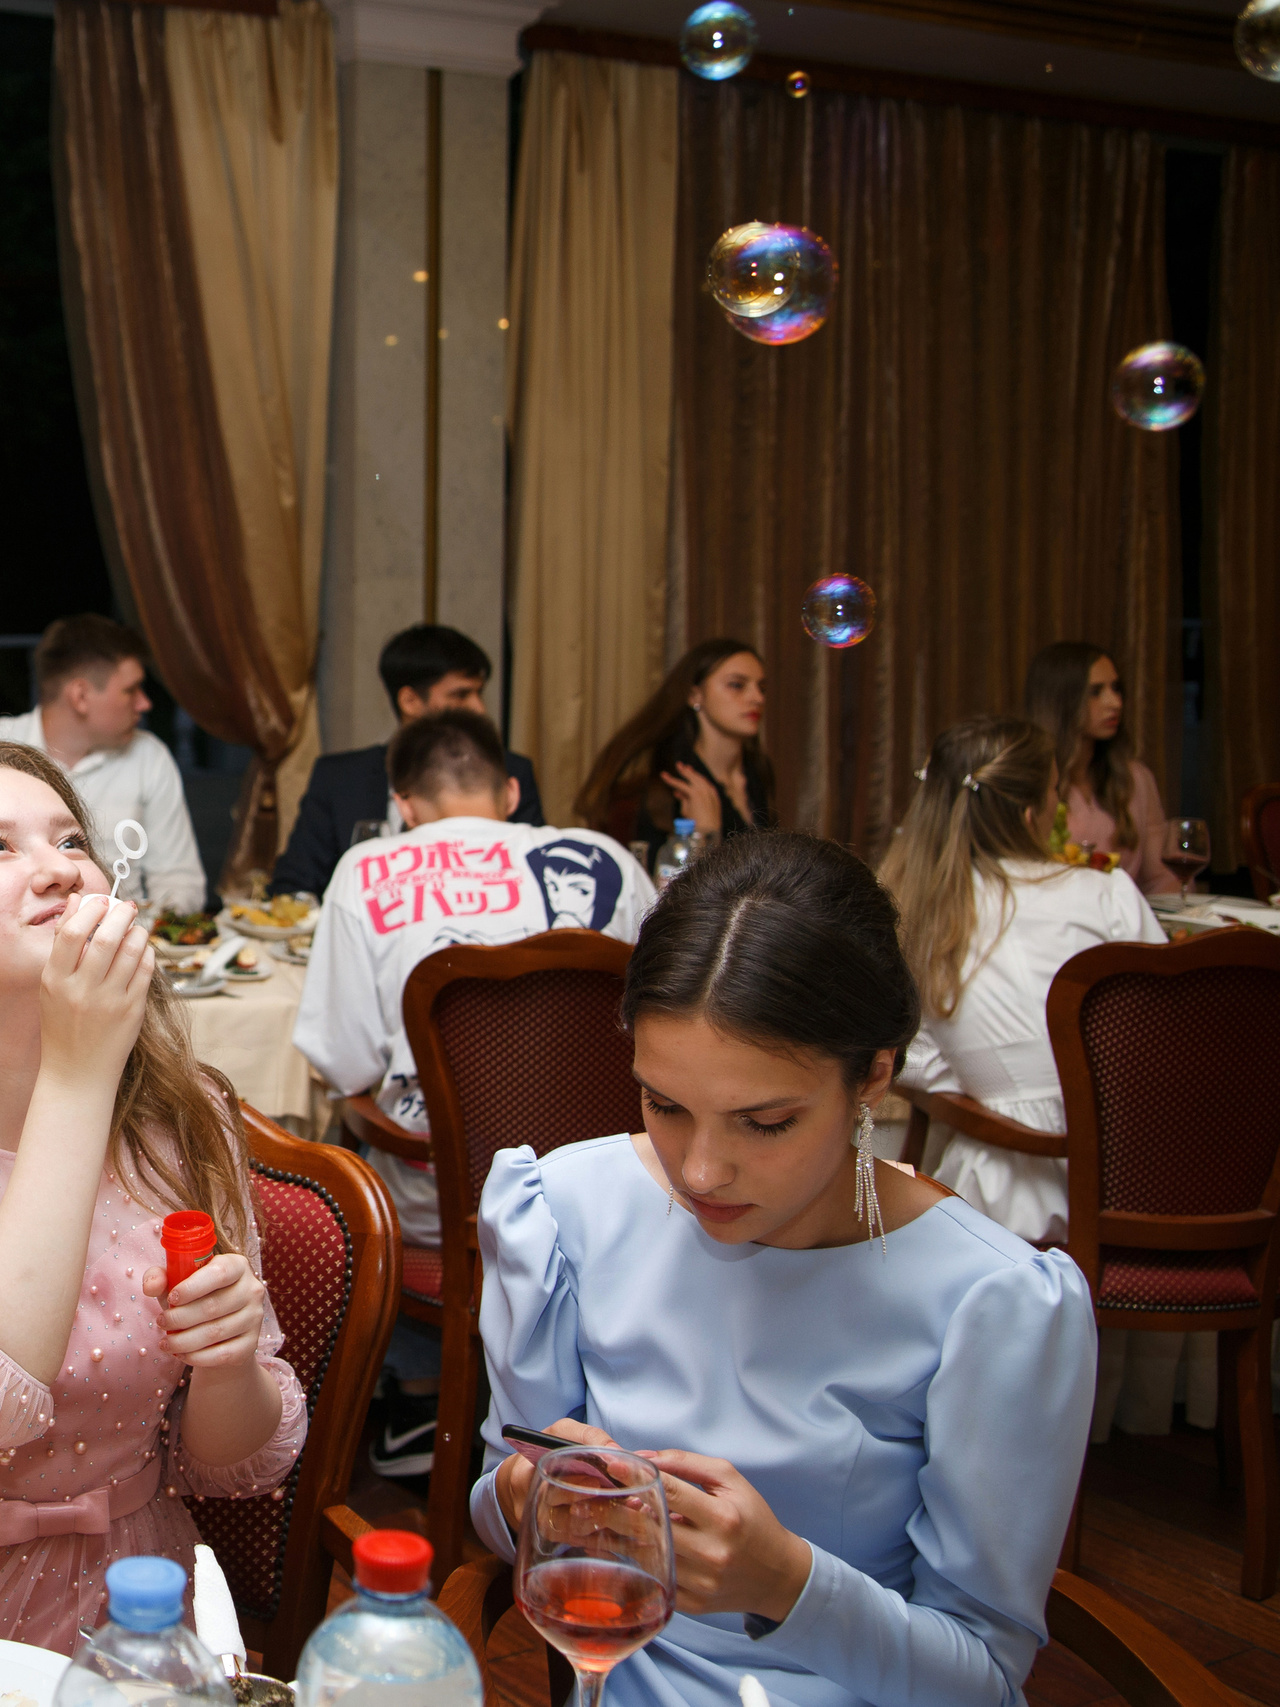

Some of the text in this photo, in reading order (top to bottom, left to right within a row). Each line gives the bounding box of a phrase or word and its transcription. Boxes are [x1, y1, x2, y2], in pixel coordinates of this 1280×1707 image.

[356, 841, 513, 891] カウボーイ
[365, 876, 522, 935] ビバップ
